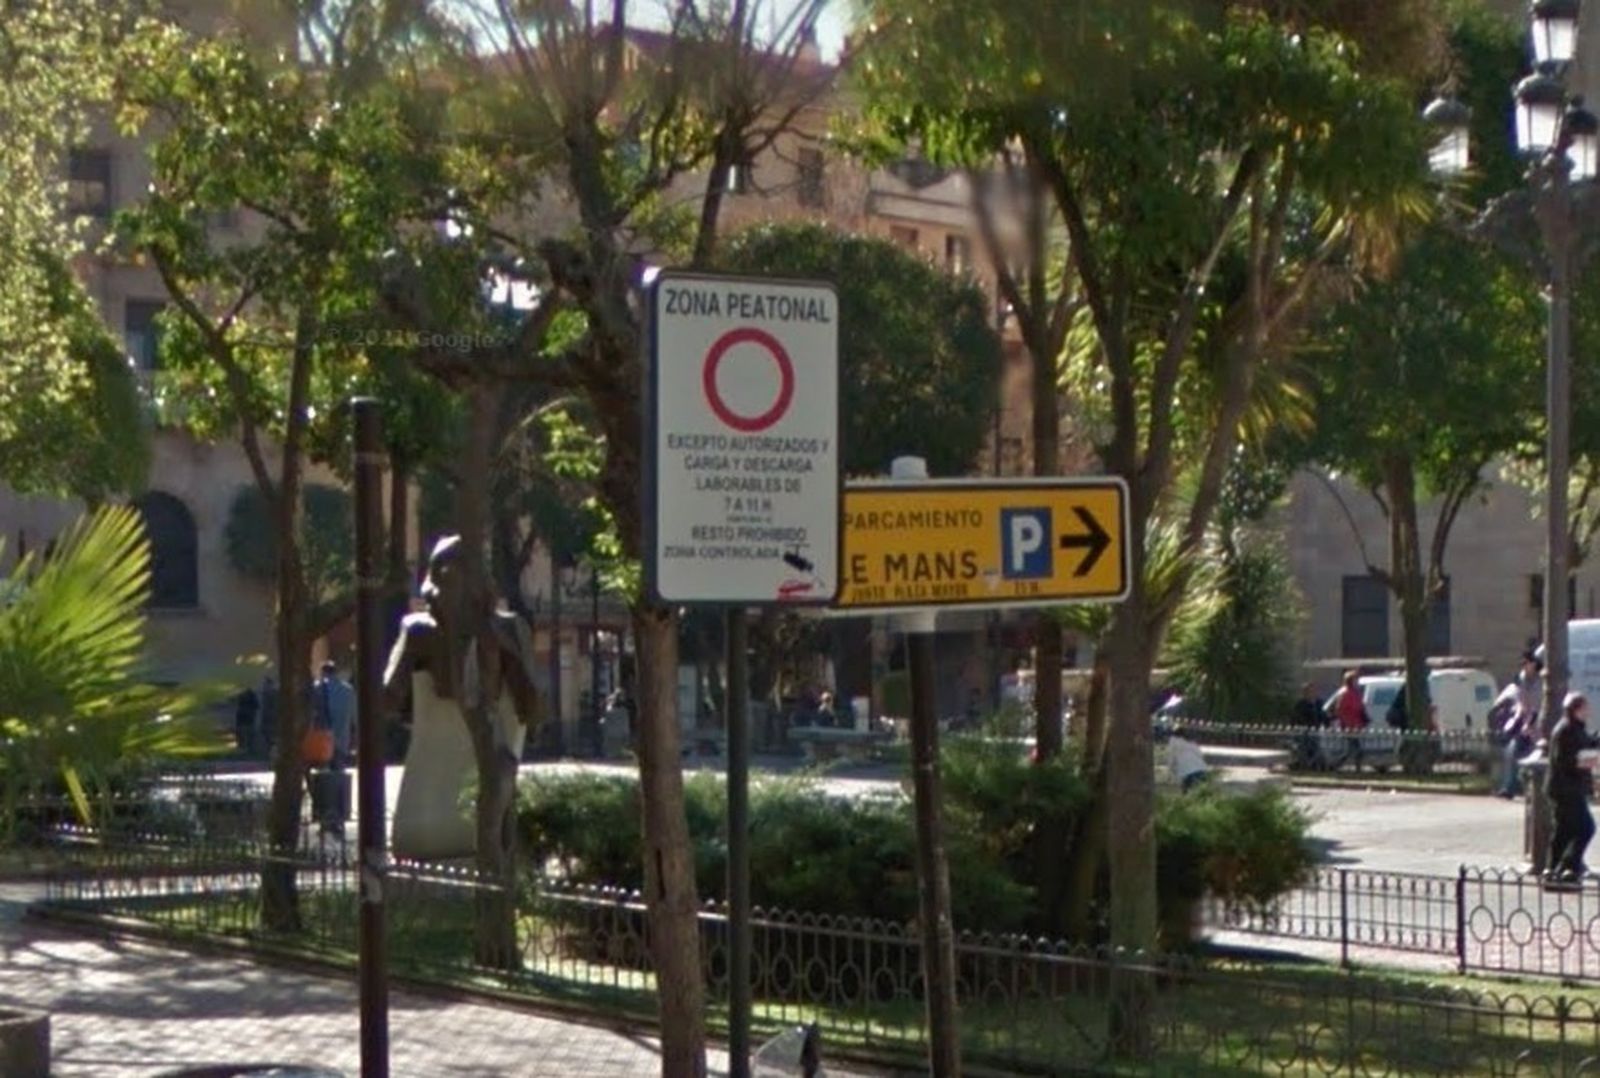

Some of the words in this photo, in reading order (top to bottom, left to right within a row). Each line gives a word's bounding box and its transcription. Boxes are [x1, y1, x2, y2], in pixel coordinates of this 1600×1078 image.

[665, 289, 721, 317] ZONA
[727, 292, 831, 323] PEATONAL
[668, 434, 727, 450] EXCEPTO
[731, 436, 819, 454] AUTORIZADOS
[821, 438, 830, 454] Y
[684, 454, 729, 470] CARGA
[733, 457, 741, 471] Y
[744, 456, 813, 473] DESCARGA
[696, 475, 782, 492] LABORABLES
[785, 477, 801, 493] DE
[733, 497, 743, 512] A
[691, 526, 734, 541] RESTO
[737, 526, 807, 542] PROHIBIDO
[1010, 514, 1043, 572] P
[663, 545, 696, 559] ZONA
[700, 545, 780, 559] CONTROLADA
[884, 551, 978, 584] MANS
